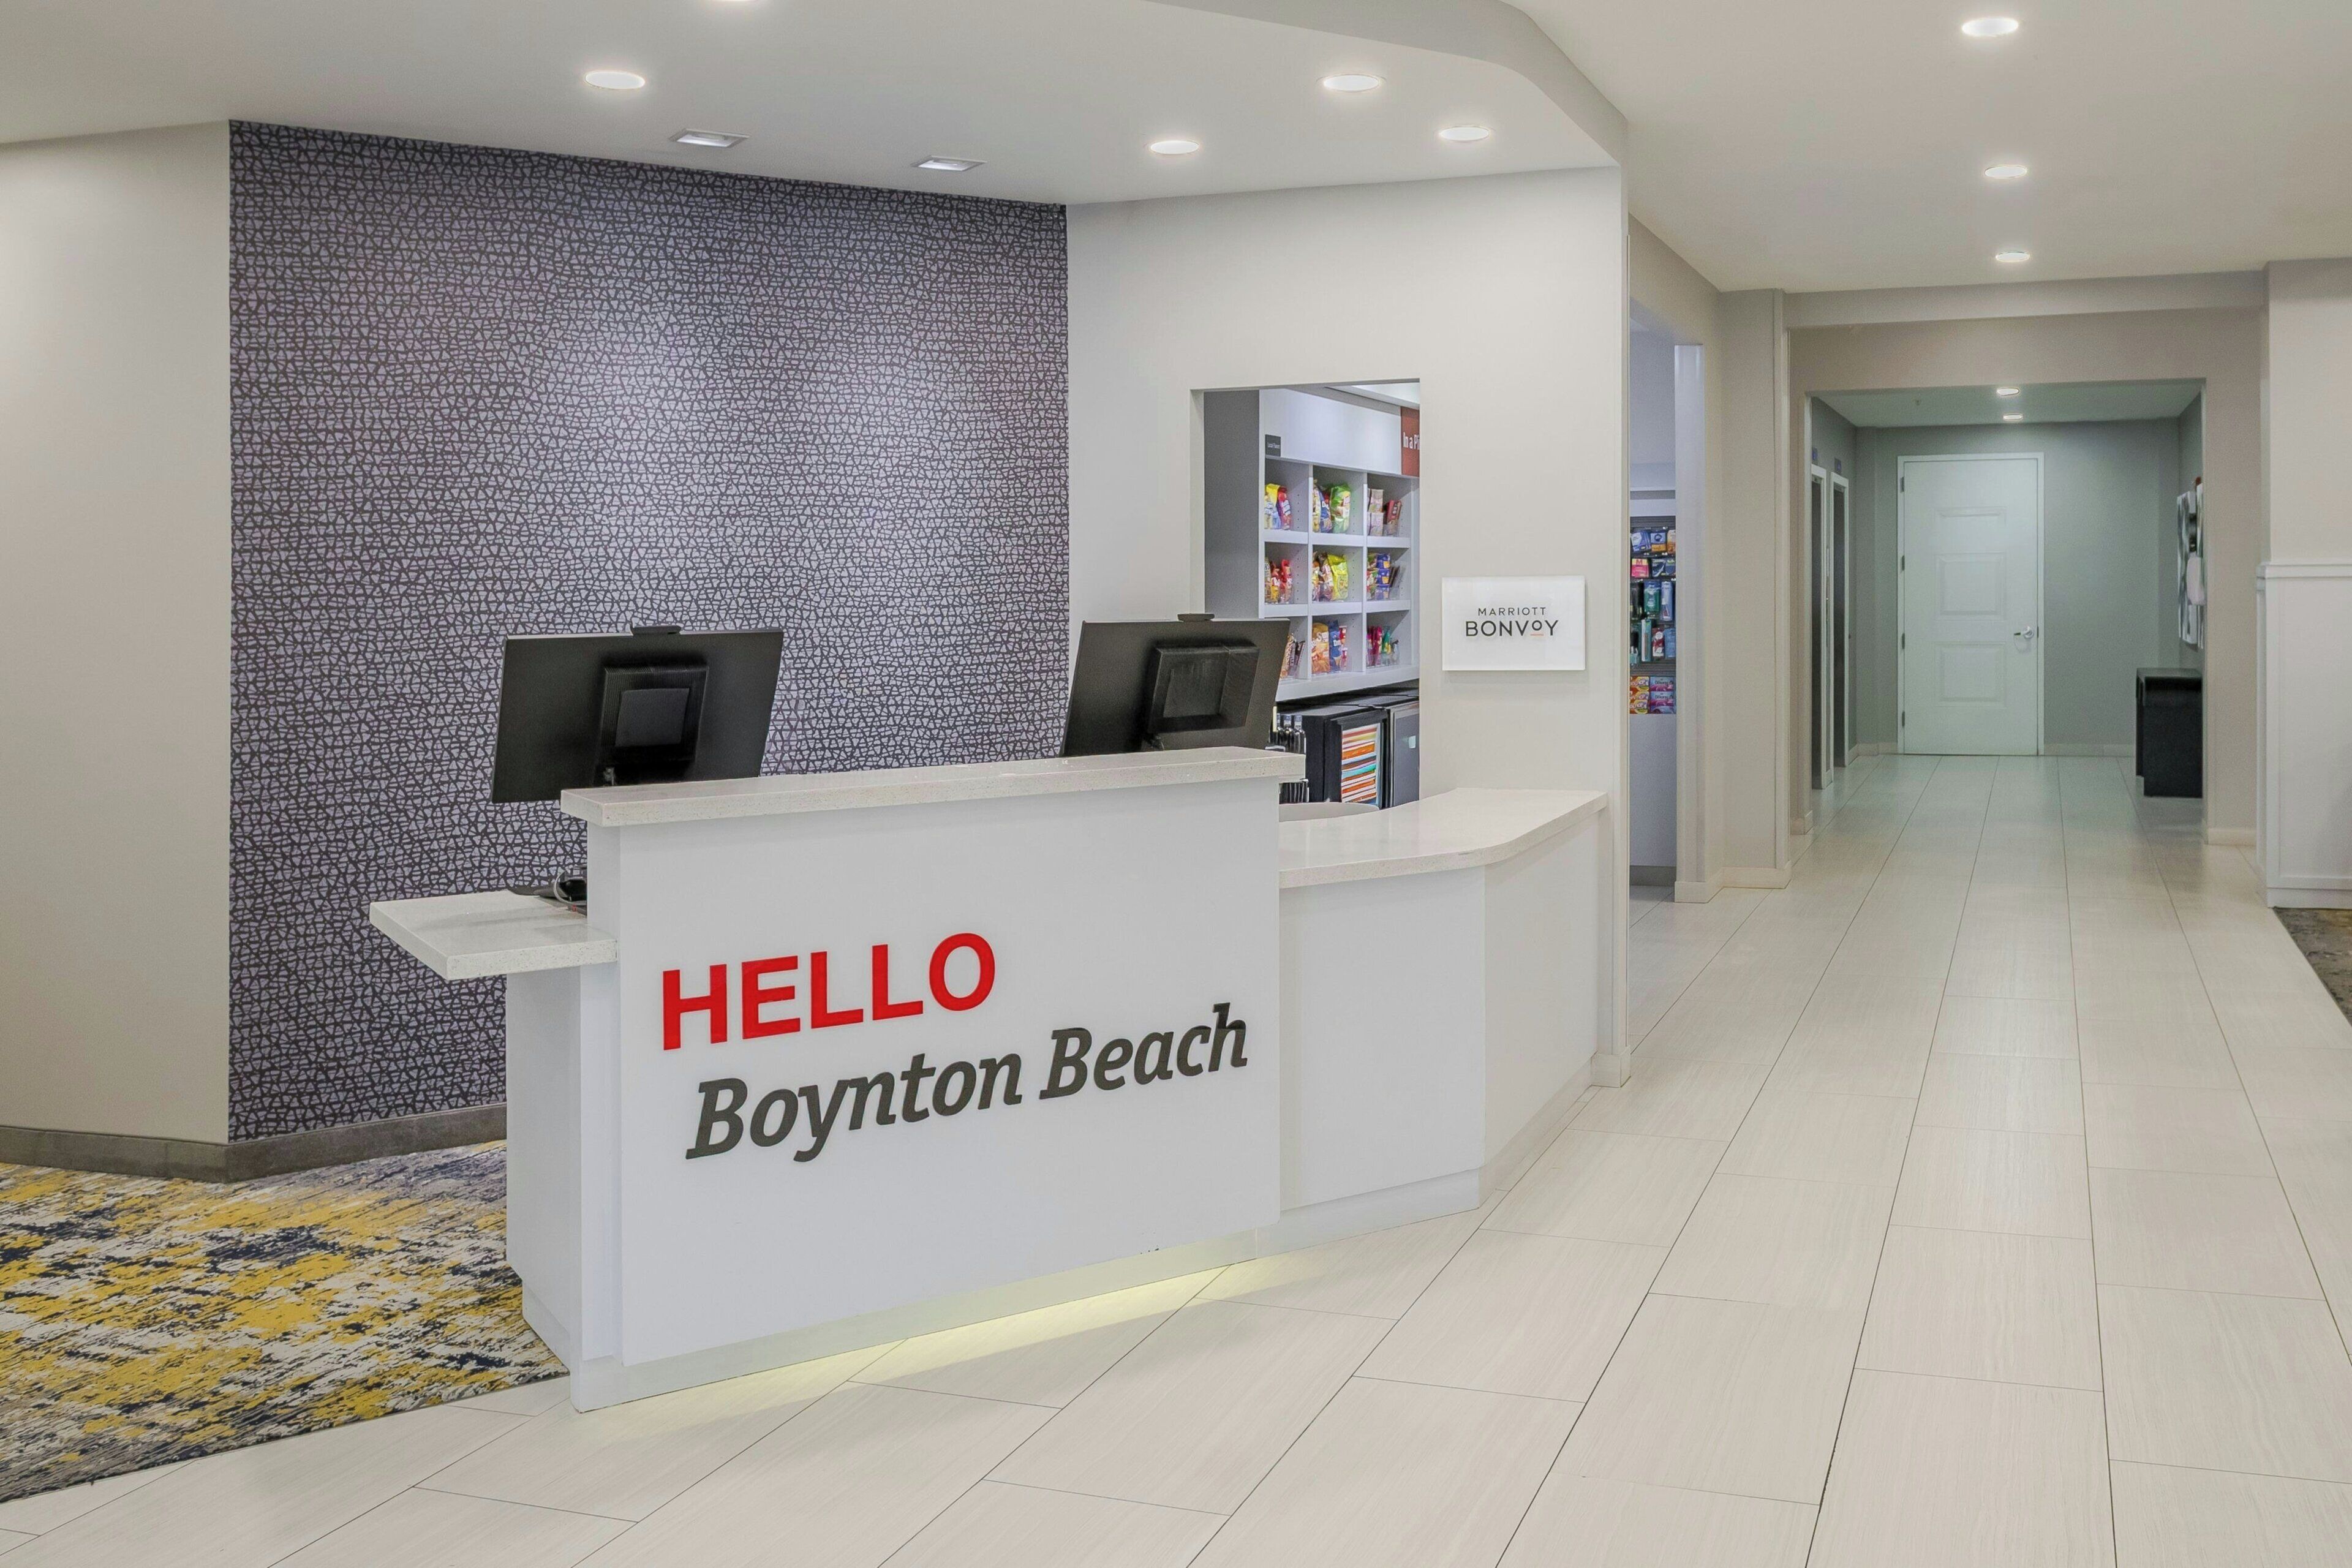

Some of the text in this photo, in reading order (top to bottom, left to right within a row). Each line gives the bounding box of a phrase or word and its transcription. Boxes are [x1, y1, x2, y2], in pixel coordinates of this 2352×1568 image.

[1403, 432, 1409, 448] In
[1409, 437, 1413, 449] a
[1478, 607, 1546, 616] MARRIOTT
[662, 933, 996, 1050] HELLO
[685, 1003, 1248, 1163] Boynton Beach
